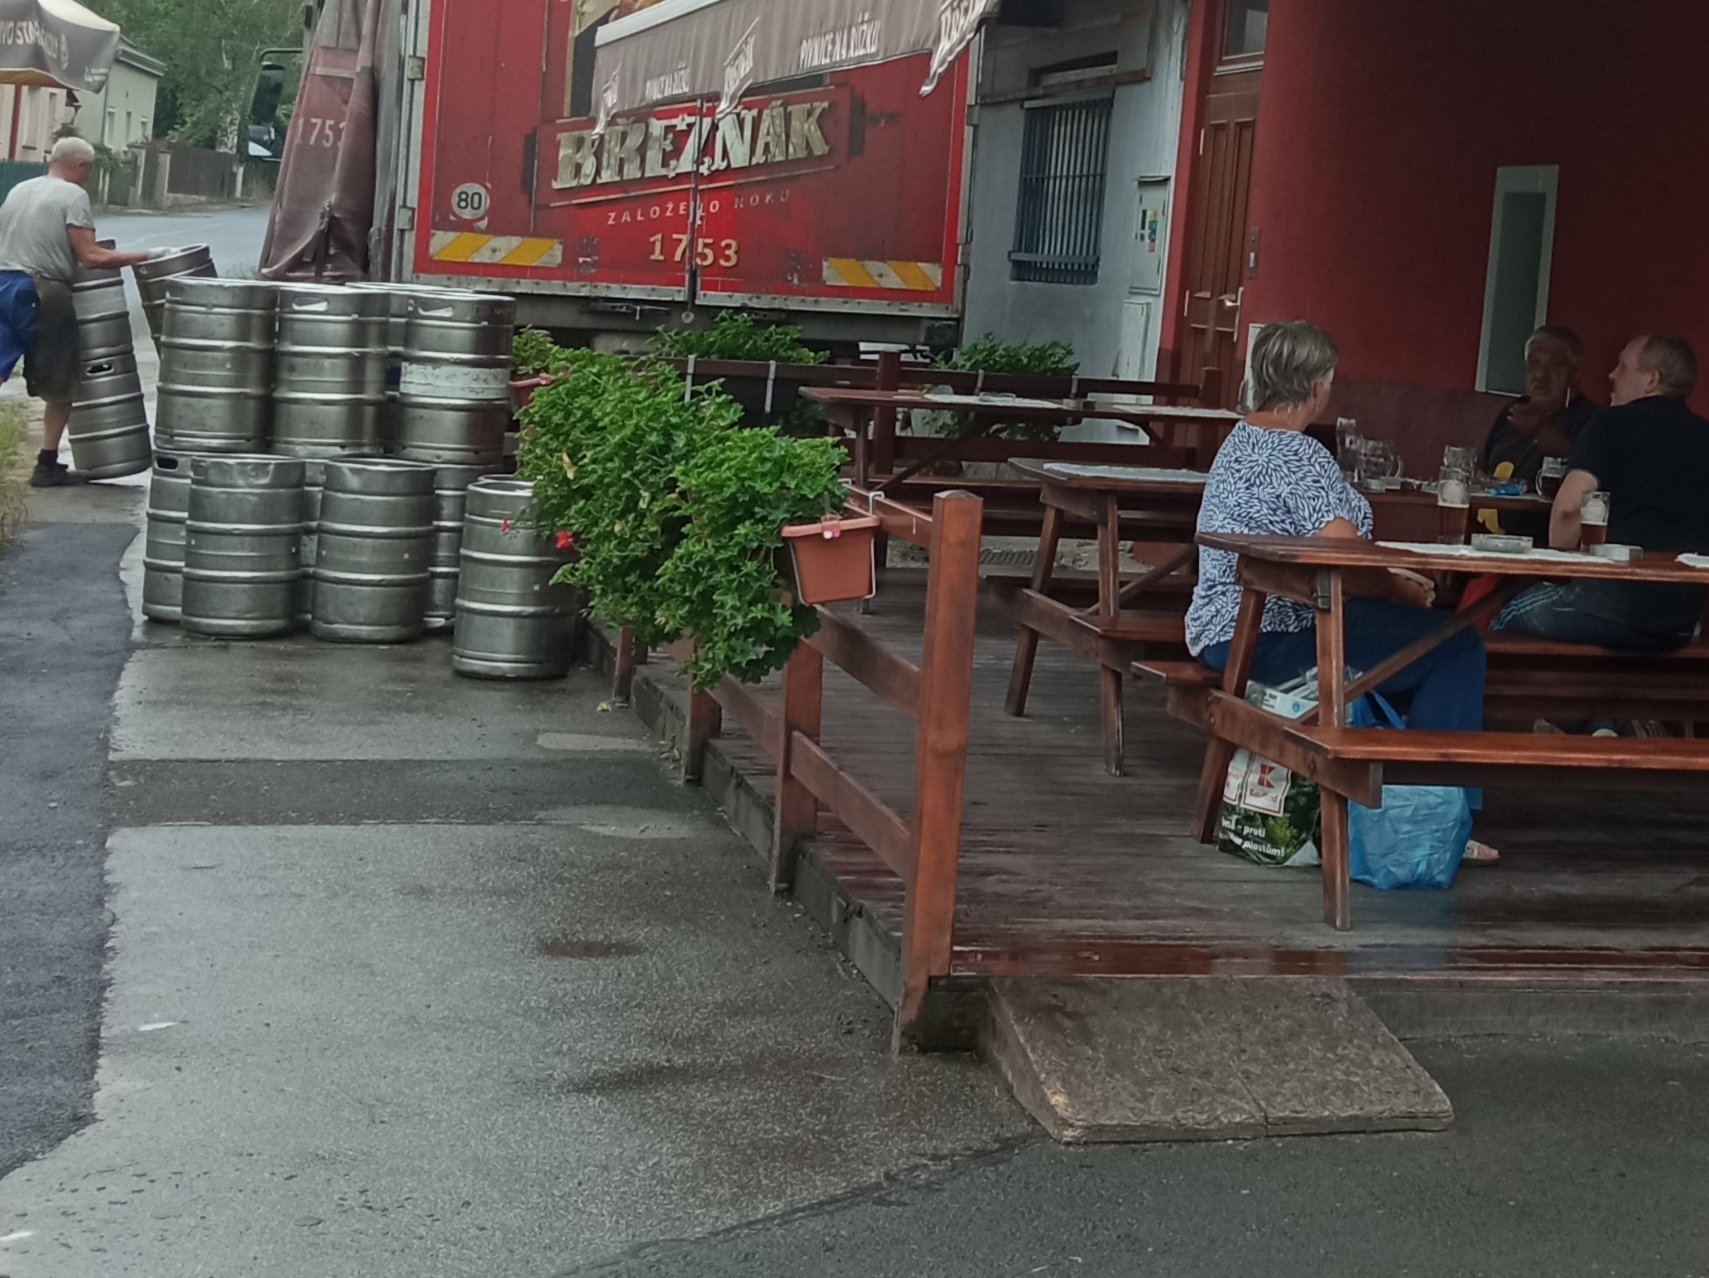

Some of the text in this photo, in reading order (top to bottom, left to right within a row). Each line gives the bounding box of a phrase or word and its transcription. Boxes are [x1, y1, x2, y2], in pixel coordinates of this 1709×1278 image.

[0, 21, 14, 45] VO
[552, 100, 830, 190] BŘEZŇÁK
[457, 191, 483, 211] 80
[649, 233, 740, 267] 1753
[1243, 825, 1266, 838] proti
